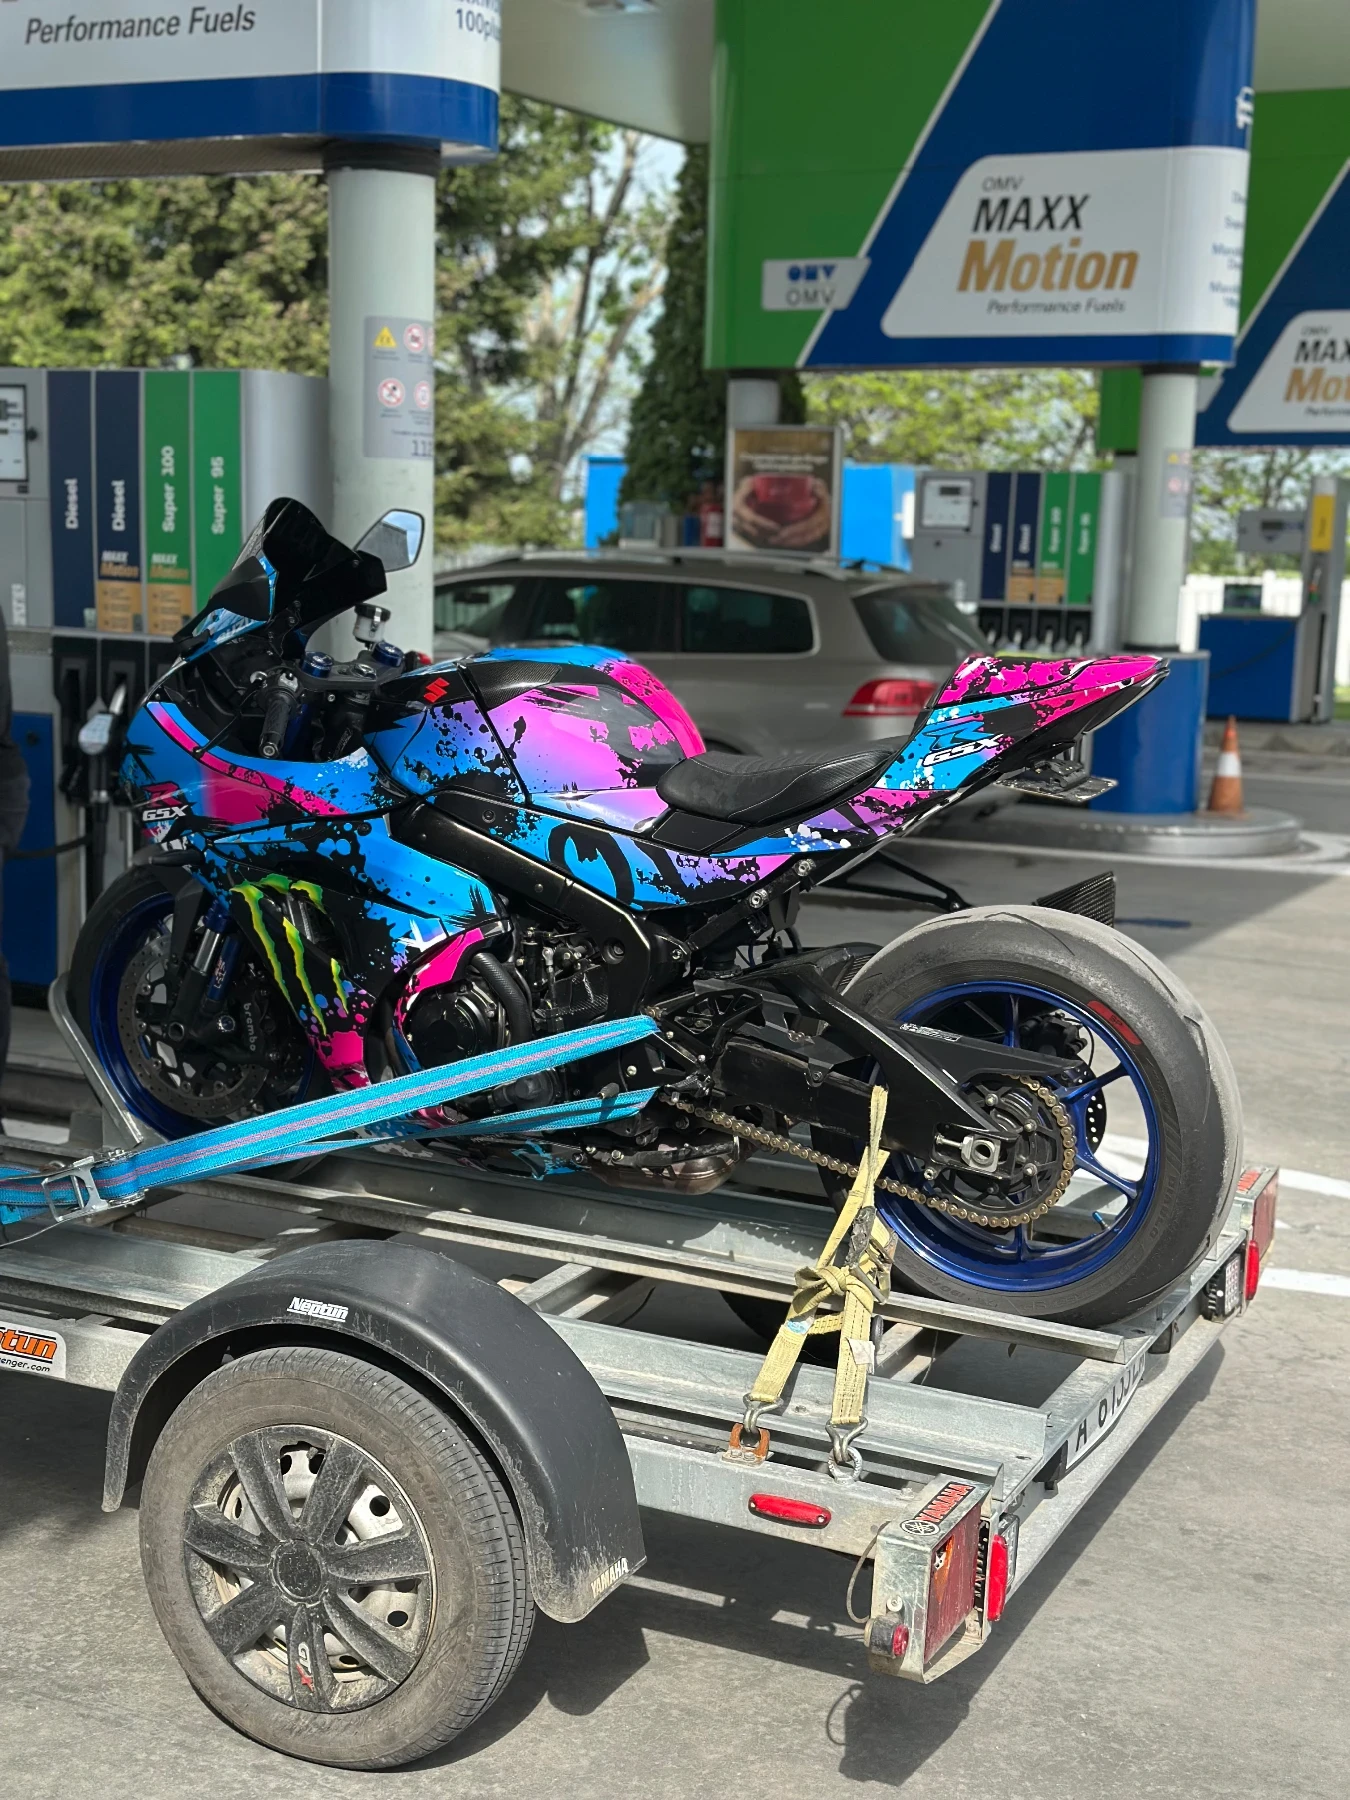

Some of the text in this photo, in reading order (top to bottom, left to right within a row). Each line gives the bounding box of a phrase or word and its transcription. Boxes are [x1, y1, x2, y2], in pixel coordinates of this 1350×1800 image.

[25, 4, 256, 44] Performance Fuels
[982, 177, 1024, 192] OMV
[972, 194, 1090, 233] MAXX
[957, 236, 1139, 292] Motion
[786, 288, 836, 306] OMV
[986, 299, 1125, 315] Performance Fuels
[64, 478, 79, 530] Diesel
[111, 480, 126, 532] Diesel
[161, 445, 178, 533] Super 100
[210, 456, 228, 535] Super 95
[923, 733, 1004, 766] GSX
[142, 804, 189, 821] GSX
[243, 1002, 258, 1052] brembo
[287, 1296, 348, 1320] Neptun
[0, 1328, 57, 1359] tun
[0, 1357, 51, 1372] enger.com
[913, 1483, 973, 1523] YAMAHA
[590, 1557, 629, 1599] YAMAHA
